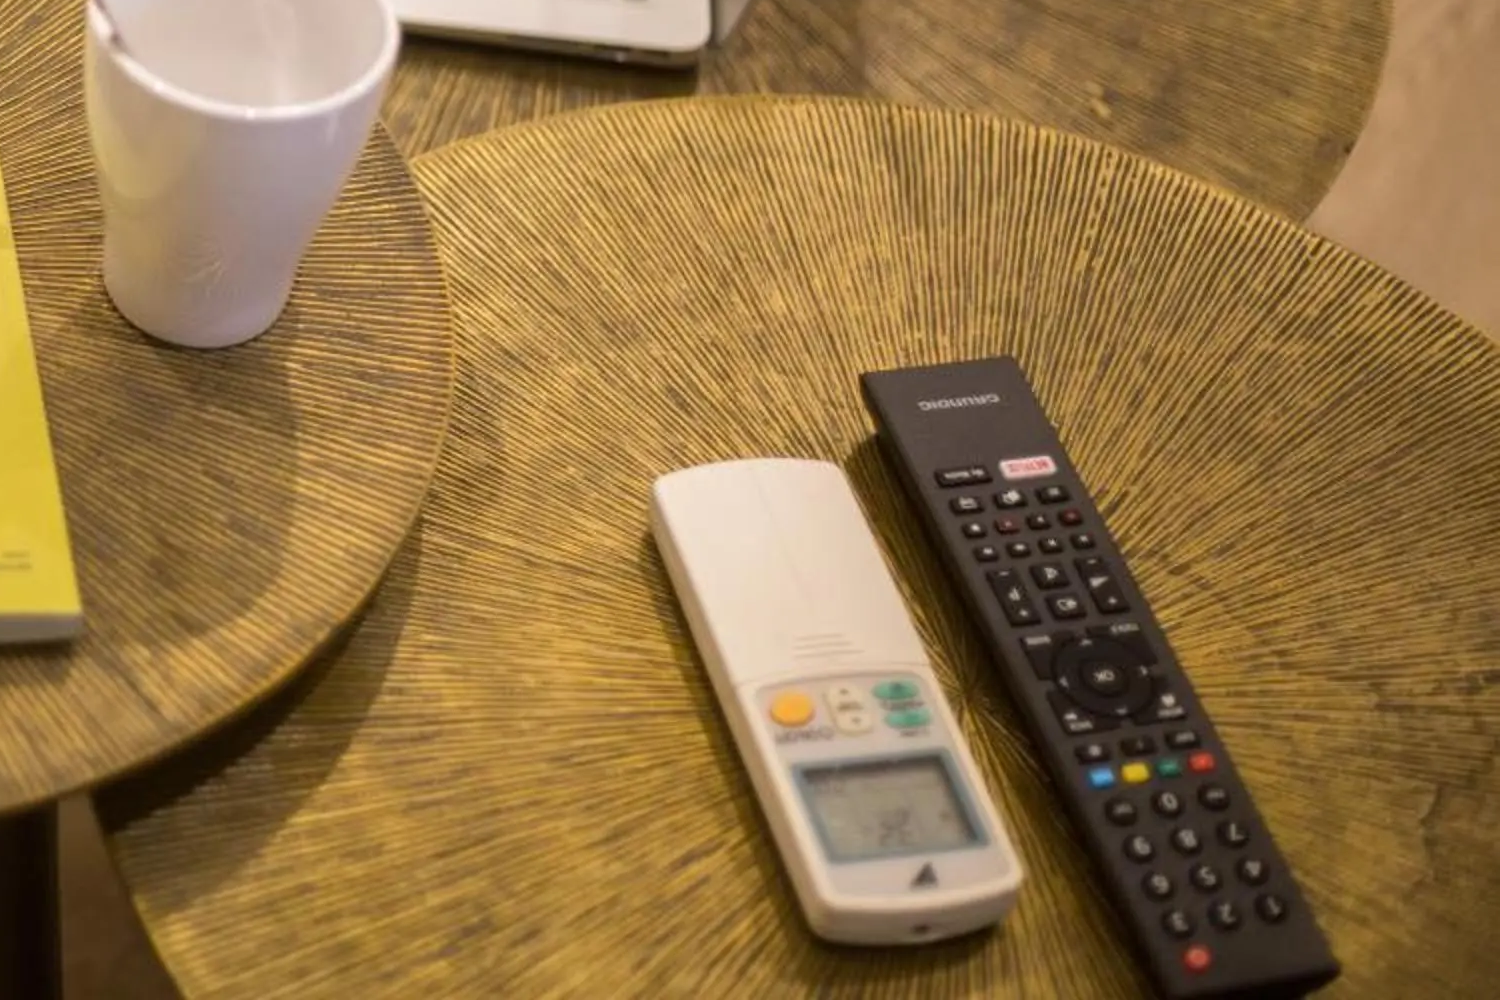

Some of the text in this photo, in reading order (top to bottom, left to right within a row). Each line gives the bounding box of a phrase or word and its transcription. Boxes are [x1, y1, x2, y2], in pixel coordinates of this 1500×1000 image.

[916, 393, 1001, 411] GRUNDIG
[1160, 792, 1179, 811] 0
[1178, 829, 1198, 848] 8
[1230, 823, 1245, 842] 7
[1132, 836, 1151, 855] 9
[1152, 875, 1169, 894] 6
[1199, 866, 1216, 886] 5
[1219, 903, 1236, 923] 2
[1267, 897, 1281, 916] 1
[1171, 910, 1189, 932] 3
